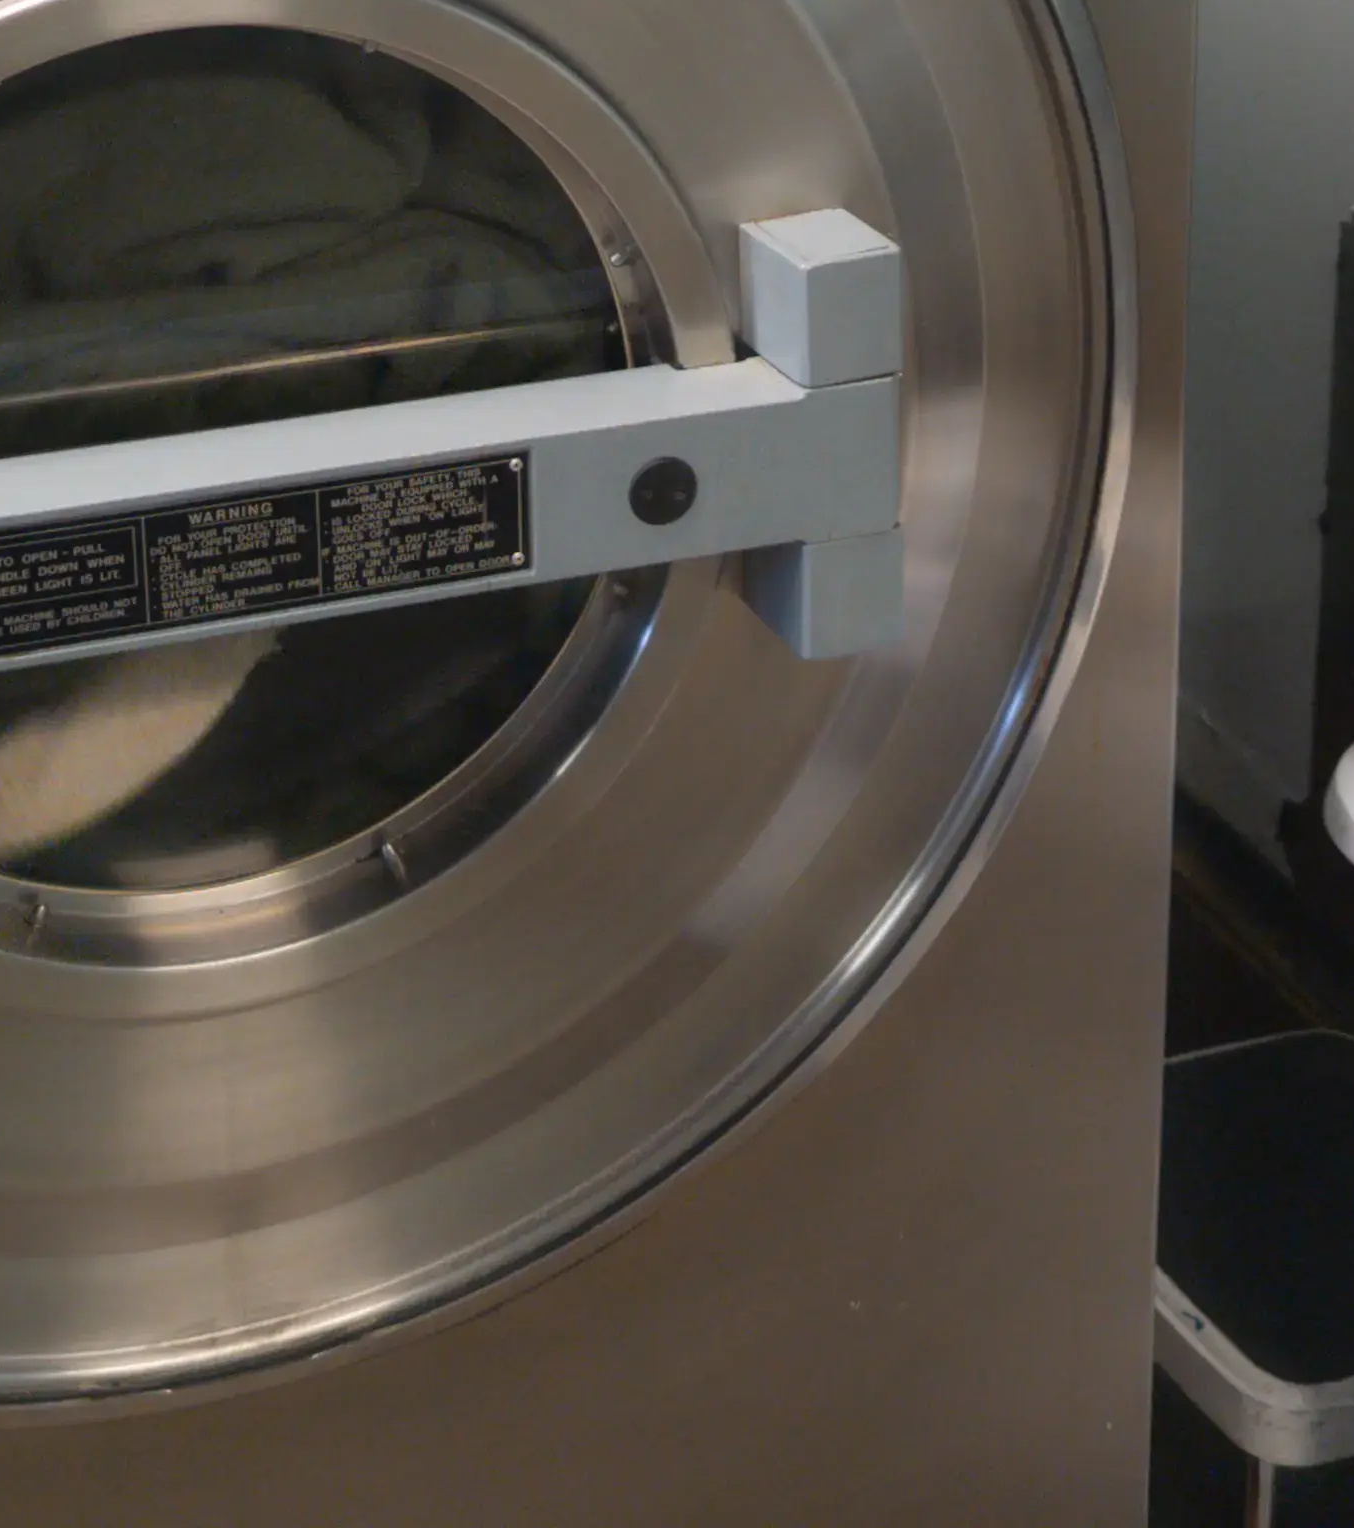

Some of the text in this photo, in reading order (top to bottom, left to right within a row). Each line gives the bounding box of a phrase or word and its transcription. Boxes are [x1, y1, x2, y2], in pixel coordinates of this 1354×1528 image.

[187, 501, 274, 525] WARNING
[21, 549, 58, 564] OPEN
[73, 543, 105, 557] PULL
[37, 561, 79, 577] DOWN
[87, 554, 125, 569] WHEN
[35, 576, 73, 592] LIGHT
[81, 573, 94, 585] IS
[61, 601, 108, 617] SHOULD
[9, 621, 41, 635] USED
